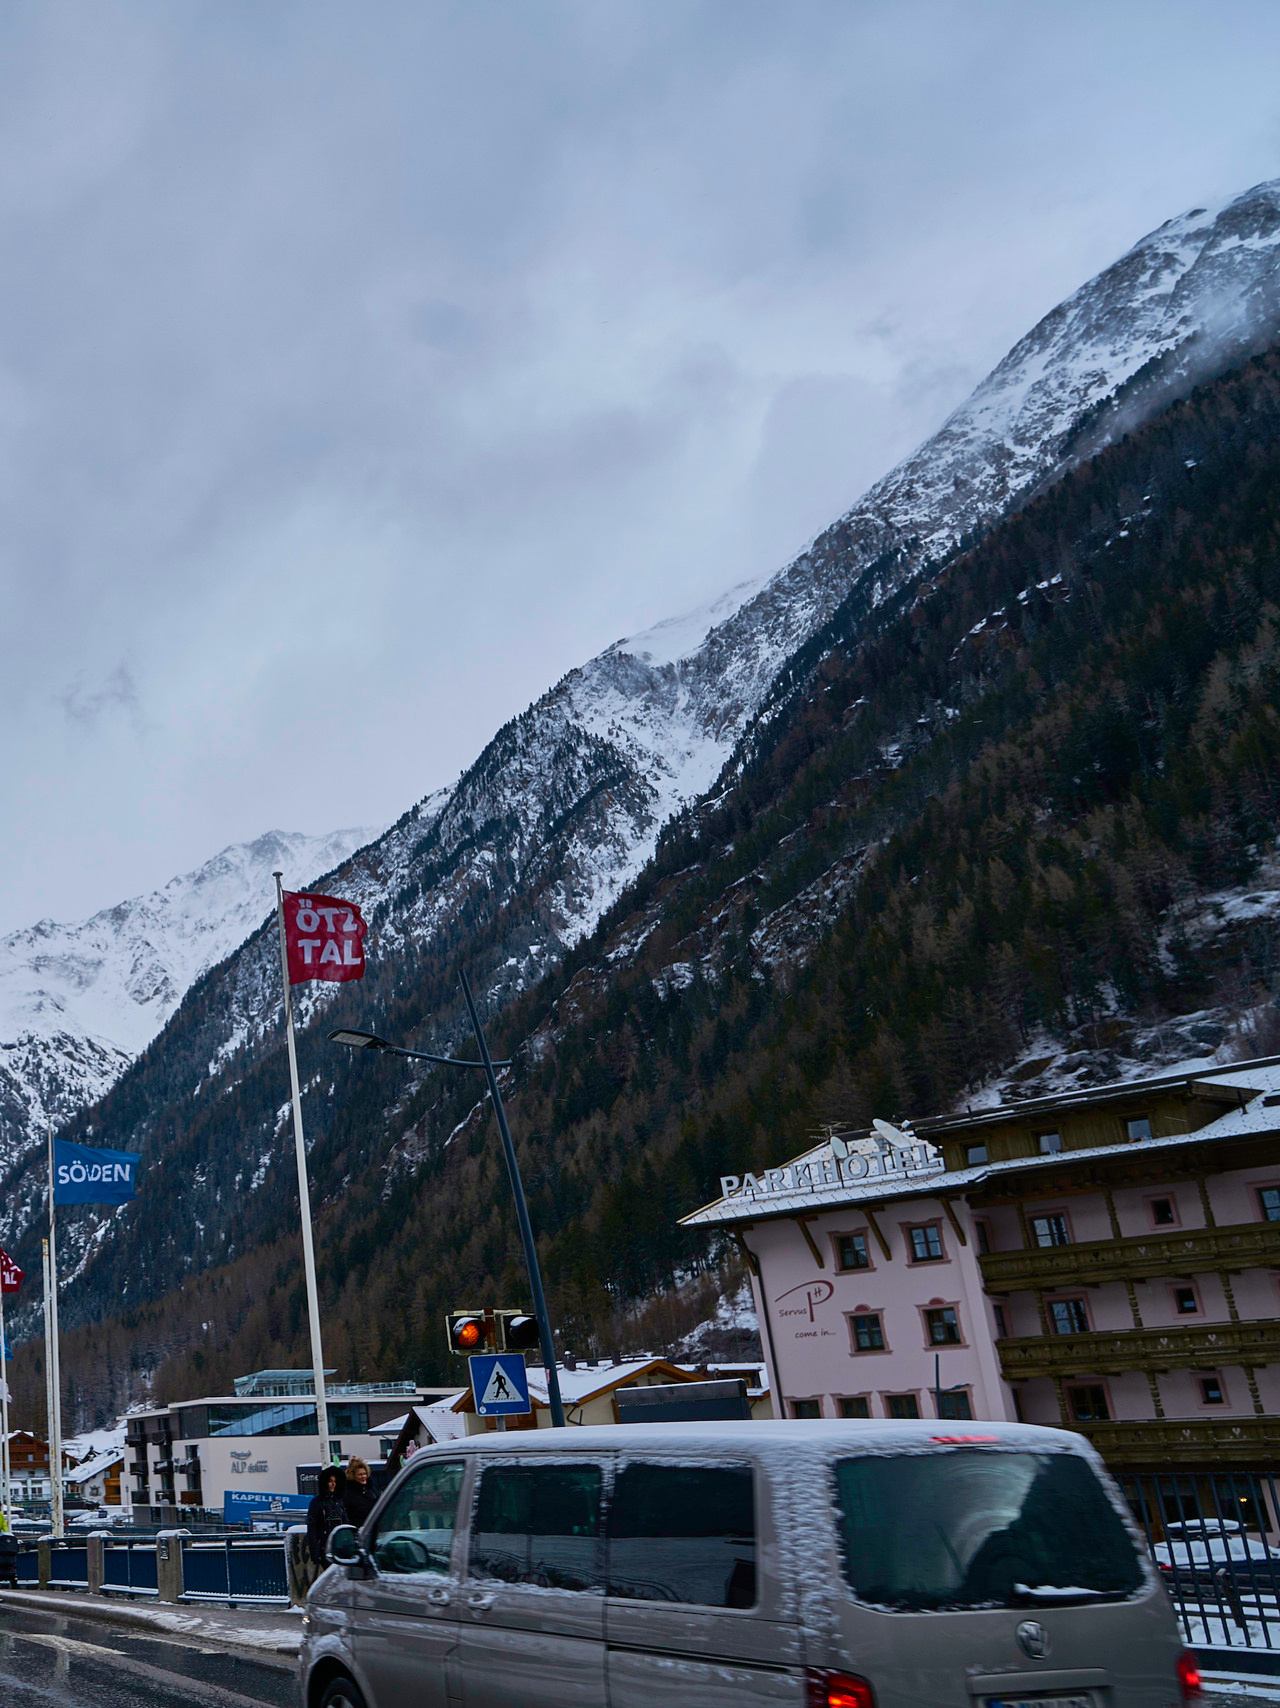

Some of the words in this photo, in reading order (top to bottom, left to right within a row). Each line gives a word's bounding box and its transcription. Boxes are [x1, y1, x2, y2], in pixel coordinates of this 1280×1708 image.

[296, 899, 357, 932] ÖTZ
[298, 939, 361, 965] TAL
[720, 1144, 939, 1199] PARKHOTEL
[779, 1308, 807, 1317] Servus
[231, 1461, 247, 1473] ALP
[300, 1473, 319, 1481] Geme
